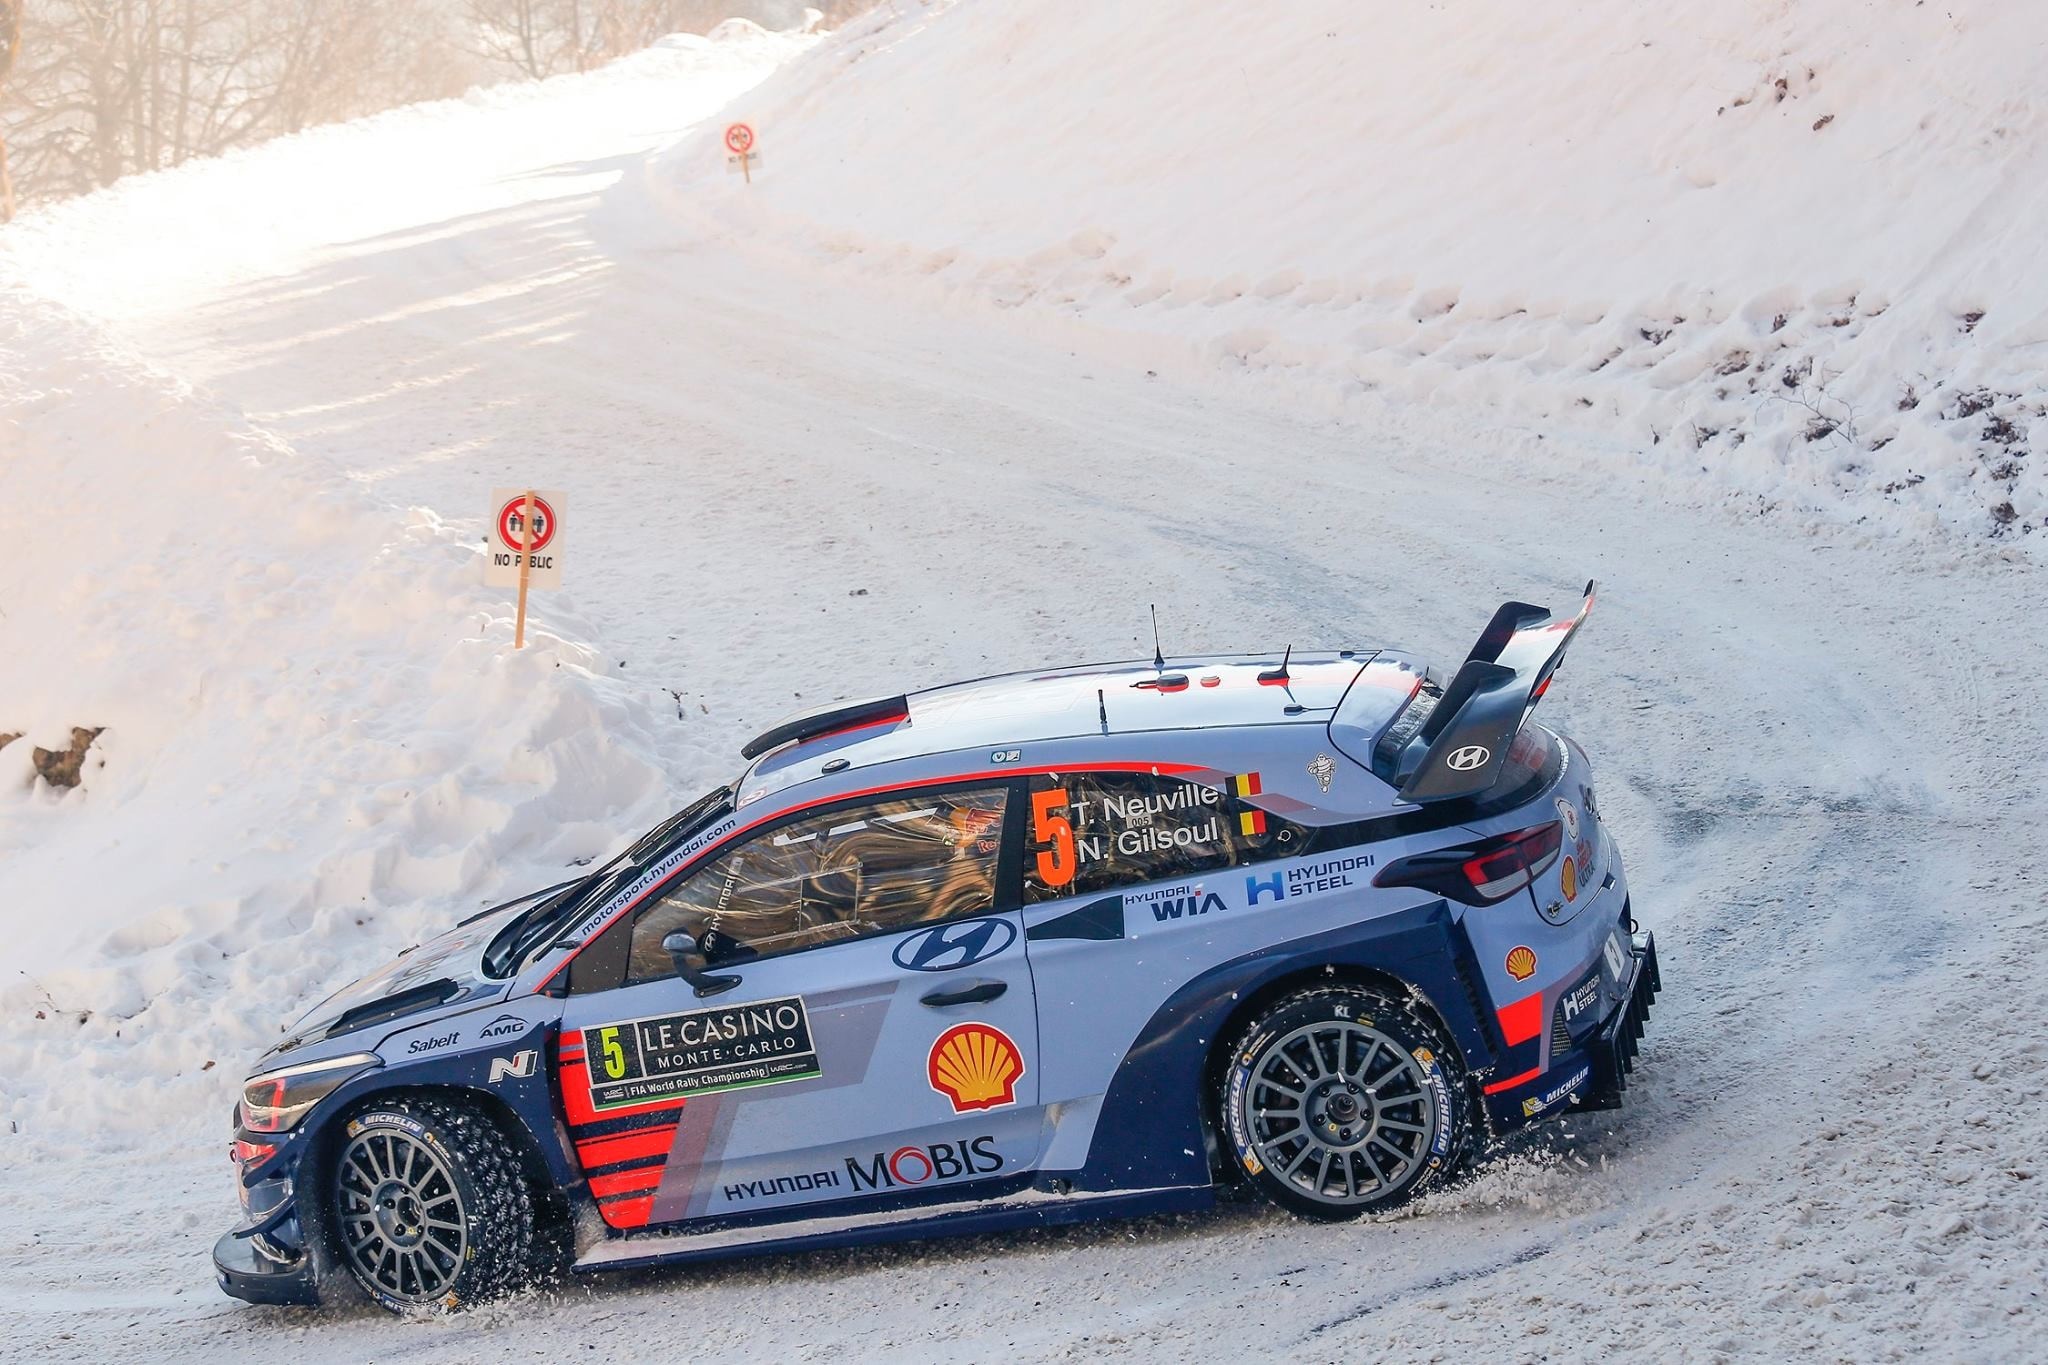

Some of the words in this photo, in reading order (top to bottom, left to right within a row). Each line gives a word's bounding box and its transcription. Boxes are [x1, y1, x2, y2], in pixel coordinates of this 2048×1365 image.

[494, 554, 510, 566] NO
[514, 555, 552, 569] PBLIC
[1071, 801, 1094, 825] T.
[1104, 783, 1219, 817] Neuville
[1032, 789, 1076, 887] 5
[1131, 816, 1149, 827] 005
[1077, 836, 1109, 863] N.
[1118, 817, 1218, 856] Gilsoul
[582, 818, 736, 936] motorsport.hyundai.com
[1288, 855, 1375, 882] HYUNDAI
[1125, 885, 1190, 905] HYUNDAI
[1290, 876, 1353, 897] STEEL
[1576, 974, 1601, 999] HYUNDAI
[1577, 991, 1598, 1011] STEEL
[407, 1032, 461, 1054] Sabelt
[644, 1024, 674, 1051] LE
[681, 1005, 799, 1046] CASINO
[600, 1026, 626, 1079] 5
[630, 1082, 647, 1096] FIA
[648, 1077, 675, 1092] World
[676, 1074, 701, 1089] Rally
[701, 1065, 765, 1085] Championship
[1546, 1067, 1590, 1102] MICHELIN
[365, 1114, 422, 1133] MICHELIN
[1231, 1070, 1246, 1148] MICHELIN
[1431, 1074, 1450, 1153] MICHELIN
[724, 1170, 841, 1200] HYUNDAI
[844, 1135, 1005, 1192] MOBIS
